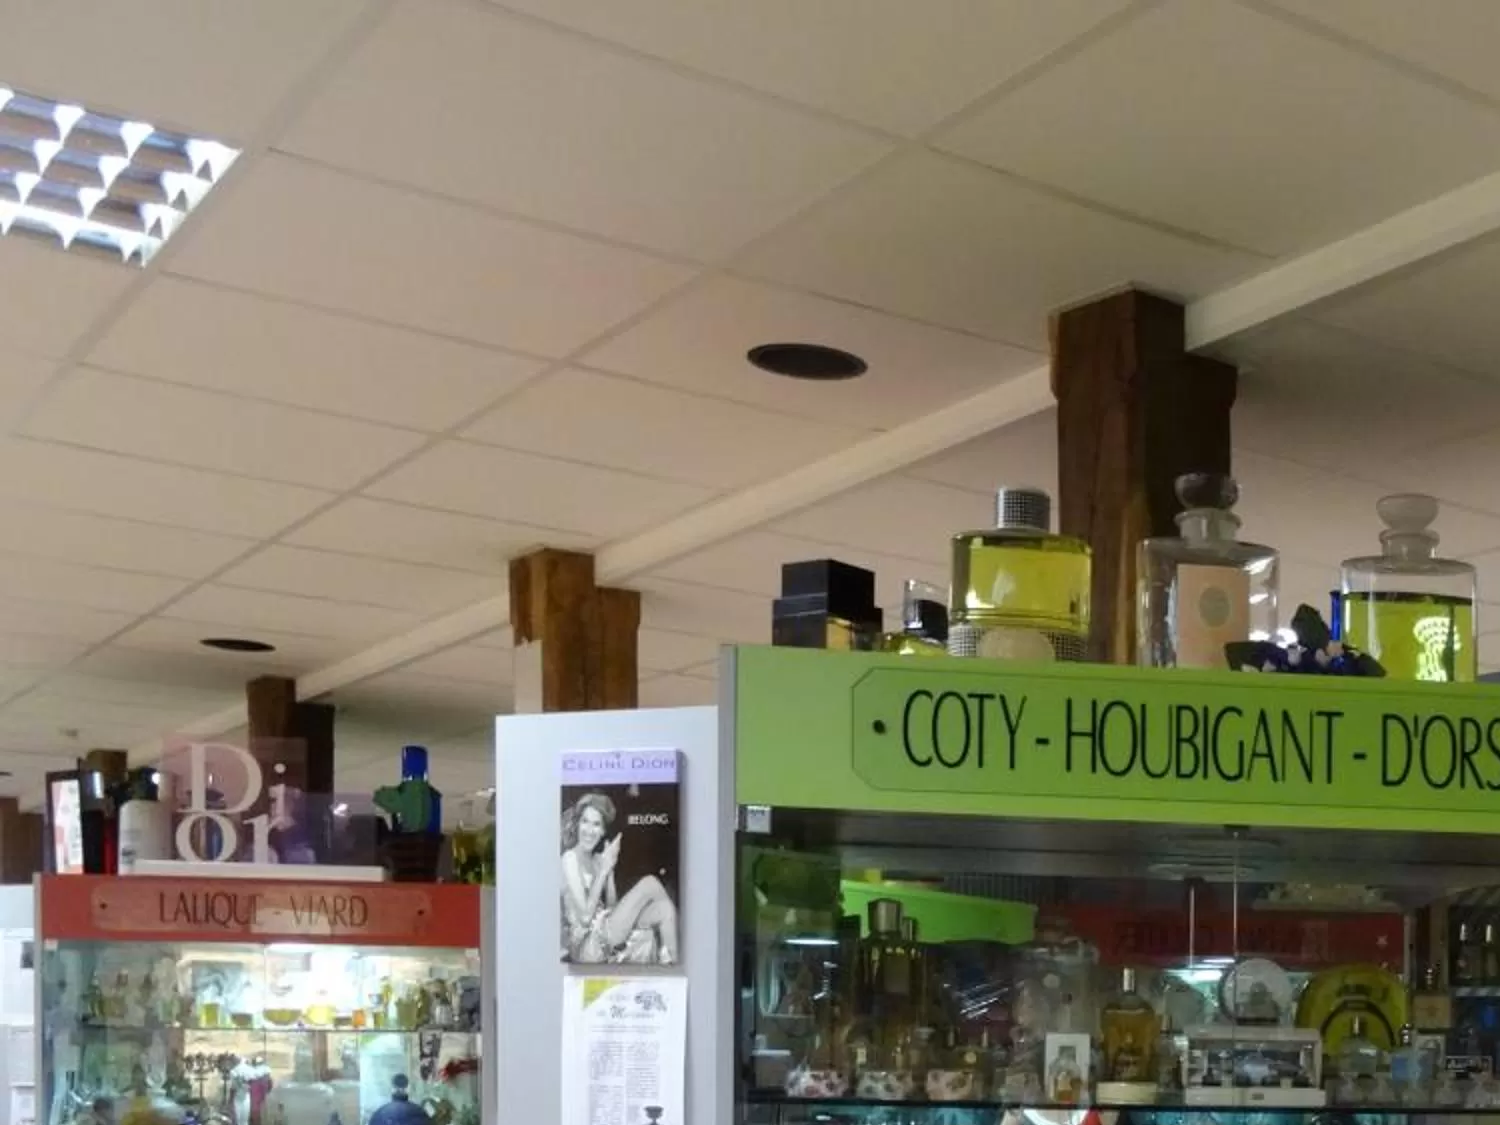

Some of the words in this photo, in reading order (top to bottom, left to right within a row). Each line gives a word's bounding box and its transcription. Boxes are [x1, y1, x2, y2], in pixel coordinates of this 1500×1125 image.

[903, 689, 1027, 770] COTY
[1065, 696, 1345, 786] HOUBIGANT
[630, 757, 675, 770] DION
[158, 891, 258, 927] LALIQUE
[289, 893, 369, 928] VIARD
